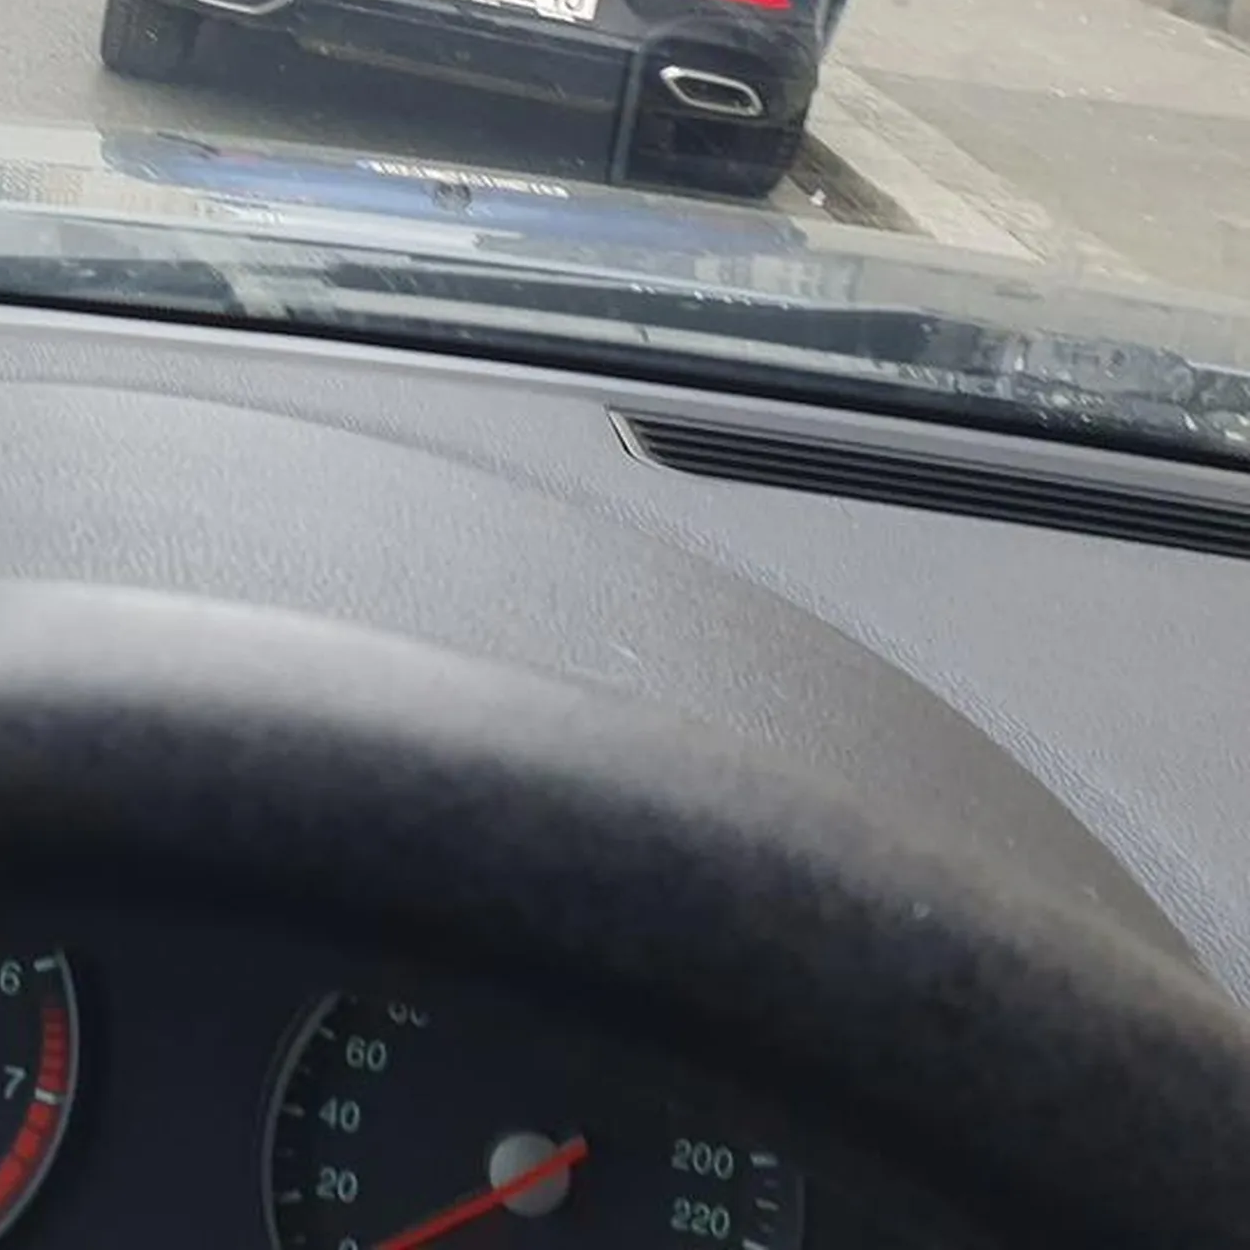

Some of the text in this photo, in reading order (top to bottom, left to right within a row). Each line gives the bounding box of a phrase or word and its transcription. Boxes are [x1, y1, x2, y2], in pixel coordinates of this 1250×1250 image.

[0, 963, 21, 995] 6
[345, 1039, 387, 1072] 60
[4, 1067, 25, 1099] 7
[319, 1096, 362, 1133] 40
[670, 1137, 735, 1181] 200
[316, 1166, 359, 1204] 20
[669, 1197, 731, 1239] 220
